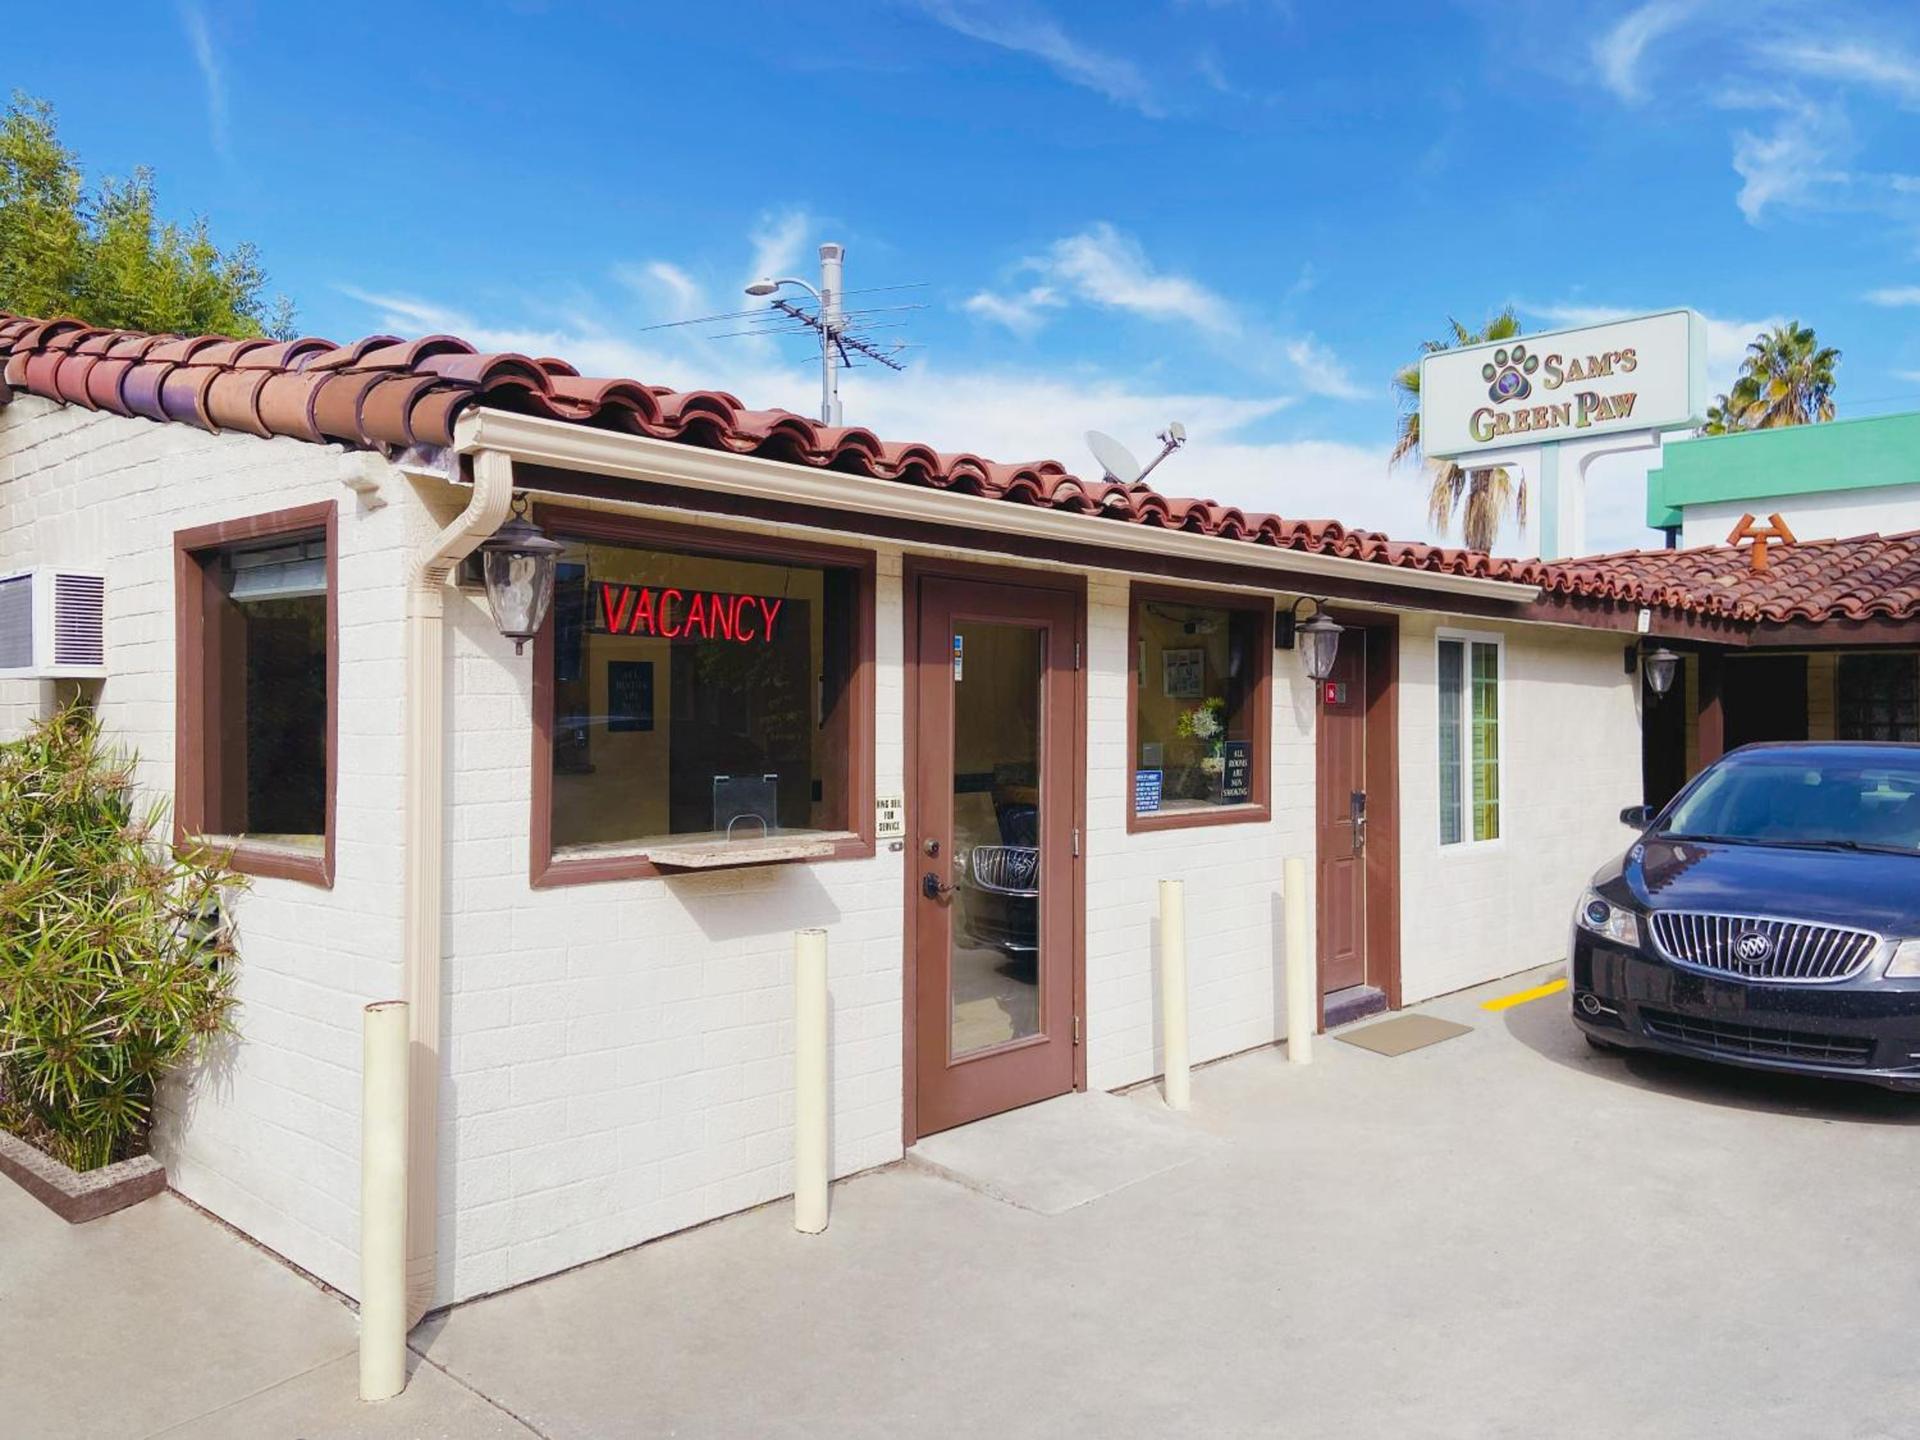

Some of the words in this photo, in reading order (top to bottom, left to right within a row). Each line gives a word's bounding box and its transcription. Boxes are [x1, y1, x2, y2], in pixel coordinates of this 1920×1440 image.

[1543, 348, 1637, 390] SAM'S
[1470, 403, 1571, 442] GREEN
[1574, 391, 1637, 428] PAW
[603, 583, 781, 642] VACANCY
